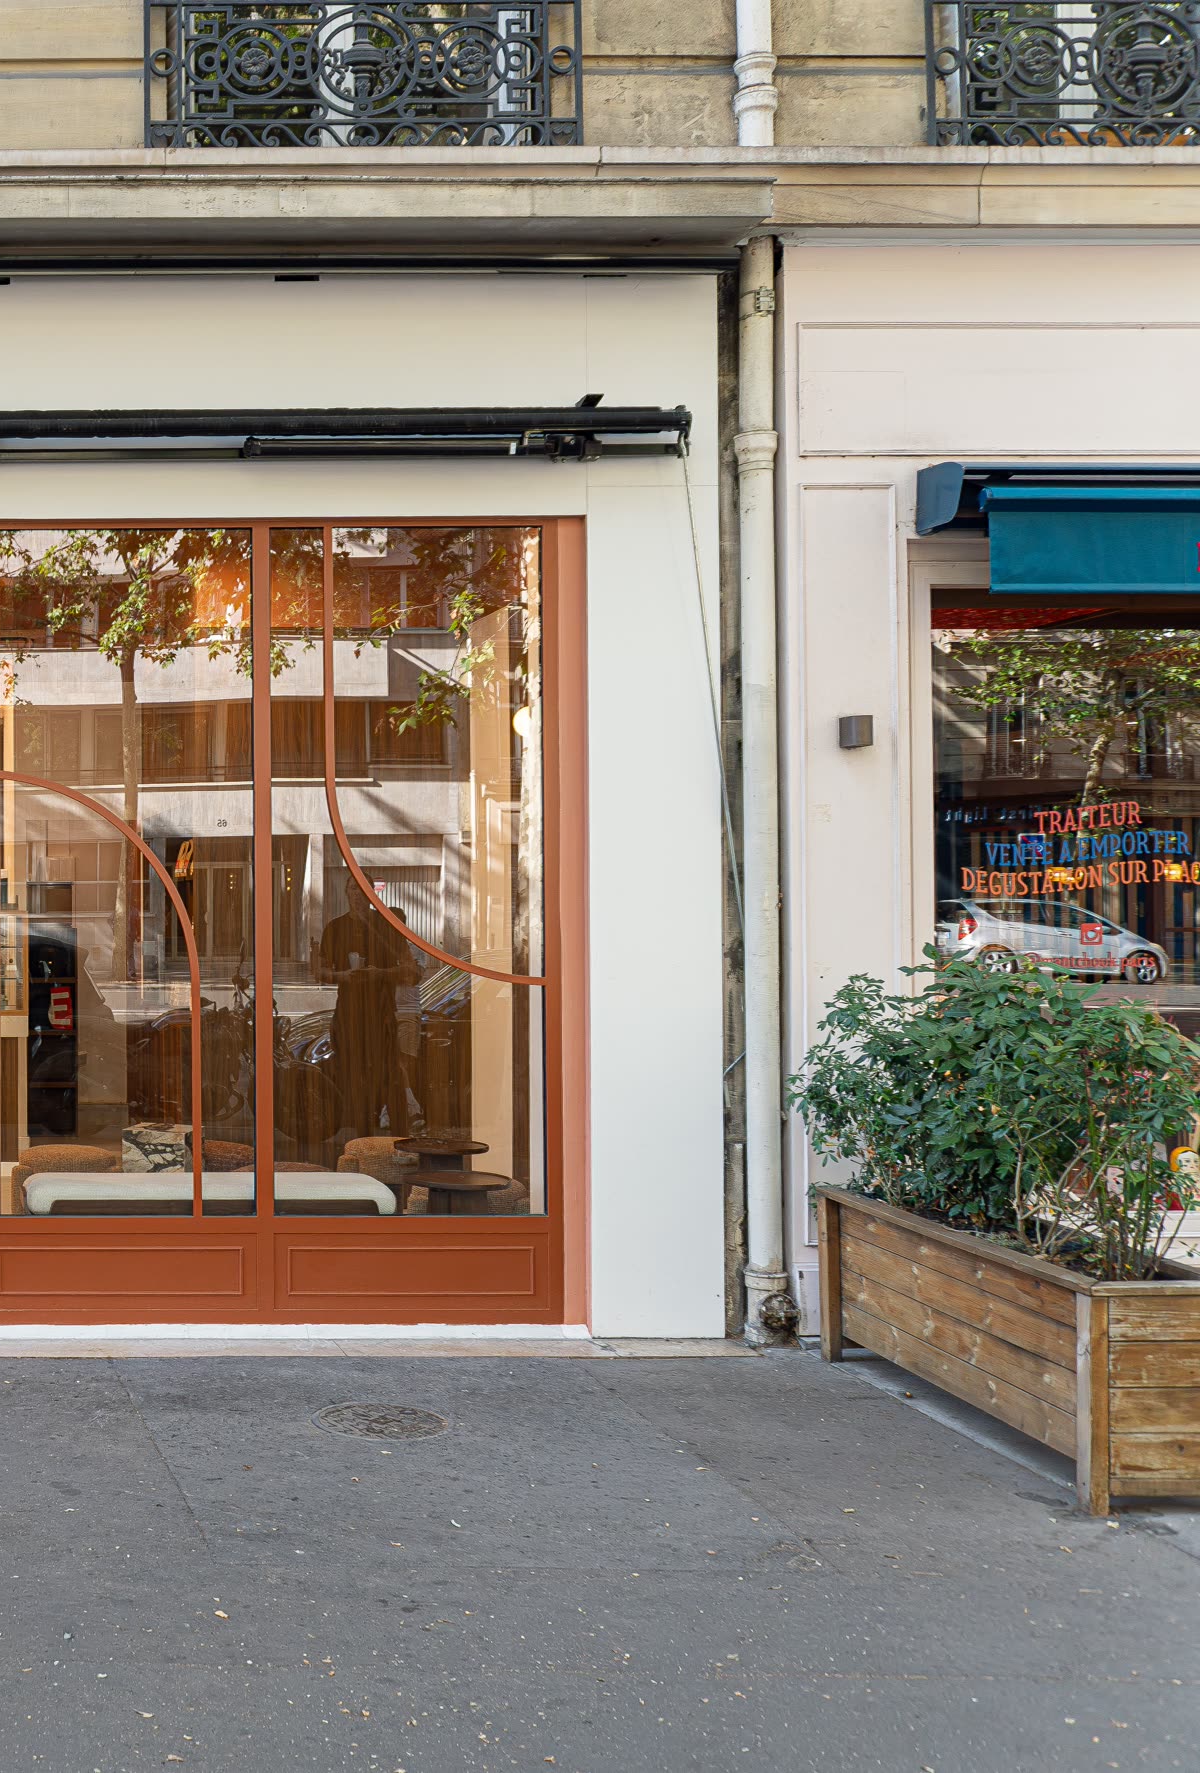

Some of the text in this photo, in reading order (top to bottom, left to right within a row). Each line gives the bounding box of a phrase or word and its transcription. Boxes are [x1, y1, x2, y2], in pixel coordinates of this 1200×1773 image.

[1033, 801, 1142, 834] TRAITEUR
[985, 831, 1192, 867] VENTE A EMPORTER
[1108, 860, 1150, 887] SUR
